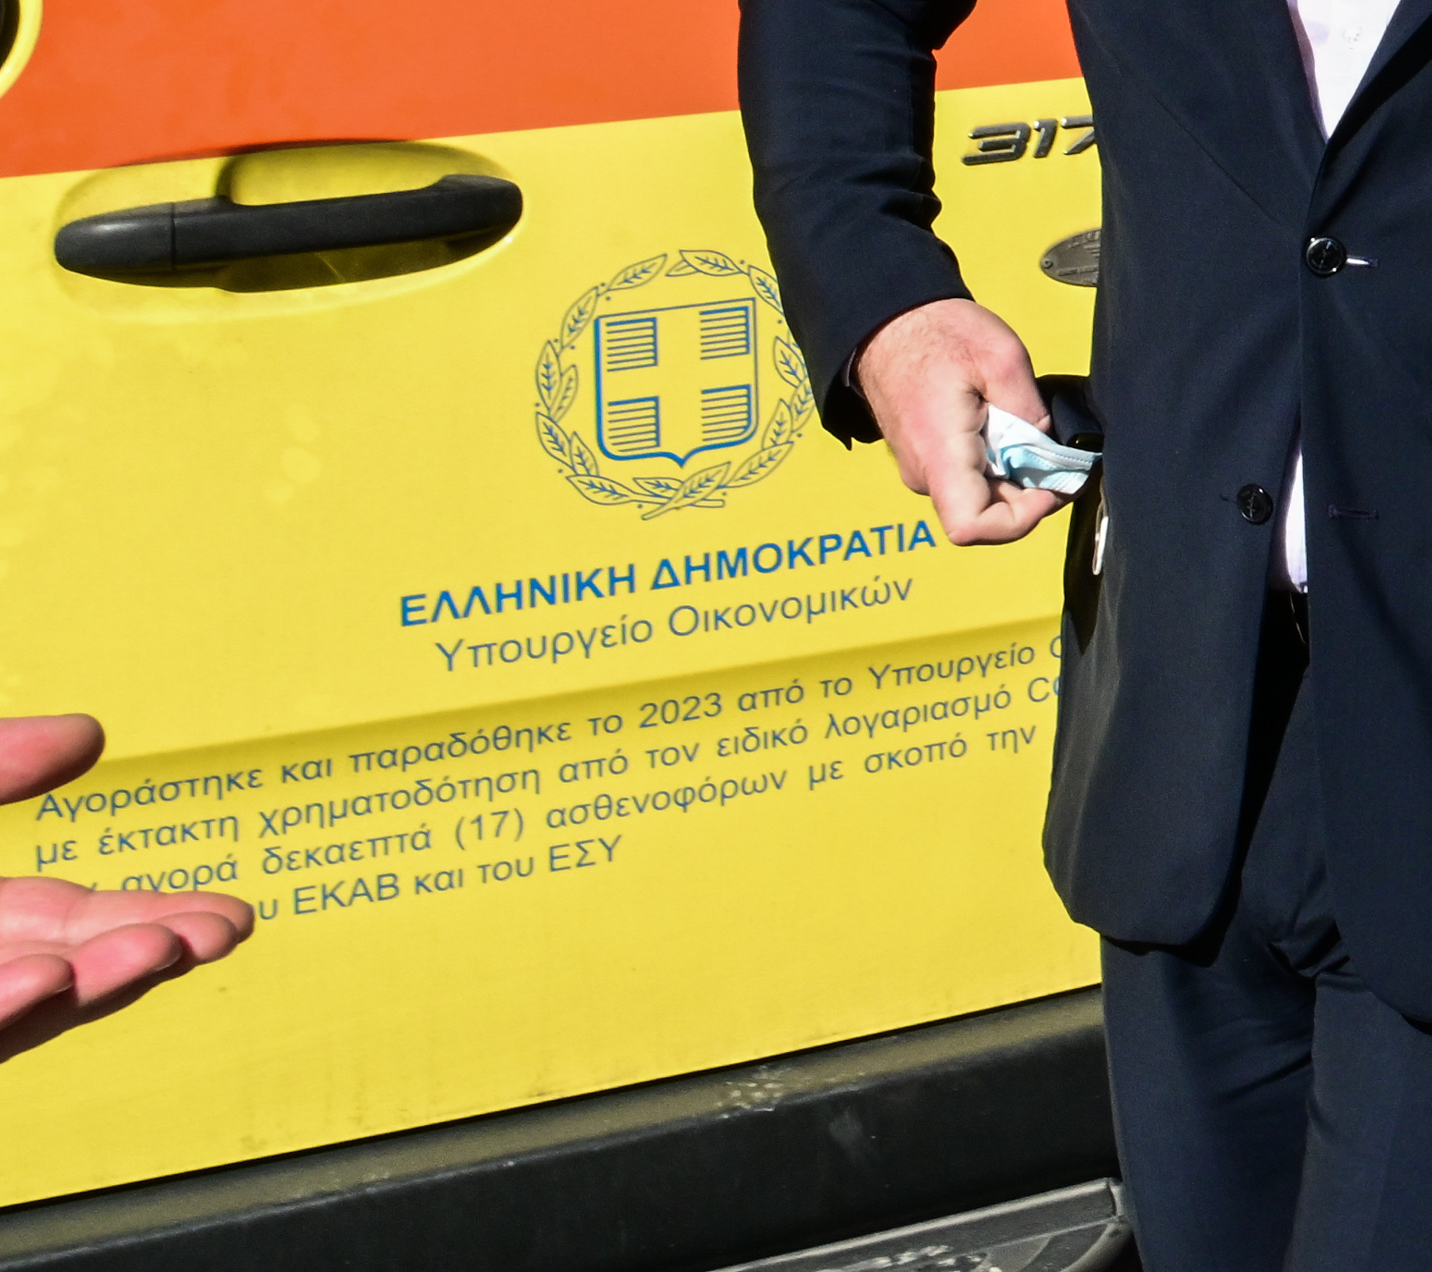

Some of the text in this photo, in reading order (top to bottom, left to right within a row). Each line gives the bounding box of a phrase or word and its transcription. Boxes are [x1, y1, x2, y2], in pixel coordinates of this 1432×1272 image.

[961, 114, 1096, 166] 317
[399, 519, 937, 628] ΕΛΛΗΝΙΚΗ ΔΗΜΟΚΡΑΤΙΑ
[434, 574, 913, 672] Υπουργείο Οικονομικών
[34, 768, 264, 823] Αγοράστηκε
[280, 758, 332, 784] και
[348, 721, 572, 774] παραδόθηκε
[587, 714, 624, 737] το
[638, 692, 723, 729] 2023
[737, 678, 805, 712] από
[819, 676, 853, 699] το
[867, 642, 1035, 690] Υπουργείο
[35, 839, 79, 873] με
[97, 815, 239, 856] έκτακτη
[258, 768, 541, 839] χρηματοδότηση
[557, 748, 629, 784] από
[644, 742, 700, 769] τον
[716, 718, 809, 758] ειδικό
[824, 683, 1012, 740] λογαριασμό
[261, 822, 432, 875] δεκαεπτά
[454, 807, 524, 851] (17)
[545, 769, 788, 829] ασθενοφόρων
[808, 760, 844, 792] με
[863, 731, 968, 774] σκοπό
[985, 725, 1037, 754] την
[292, 872, 401, 916] ΕΚΑΒ
[414, 868, 464, 896] και
[476, 856, 535, 884] του
[548, 834, 622, 873] ΕΣΥ
